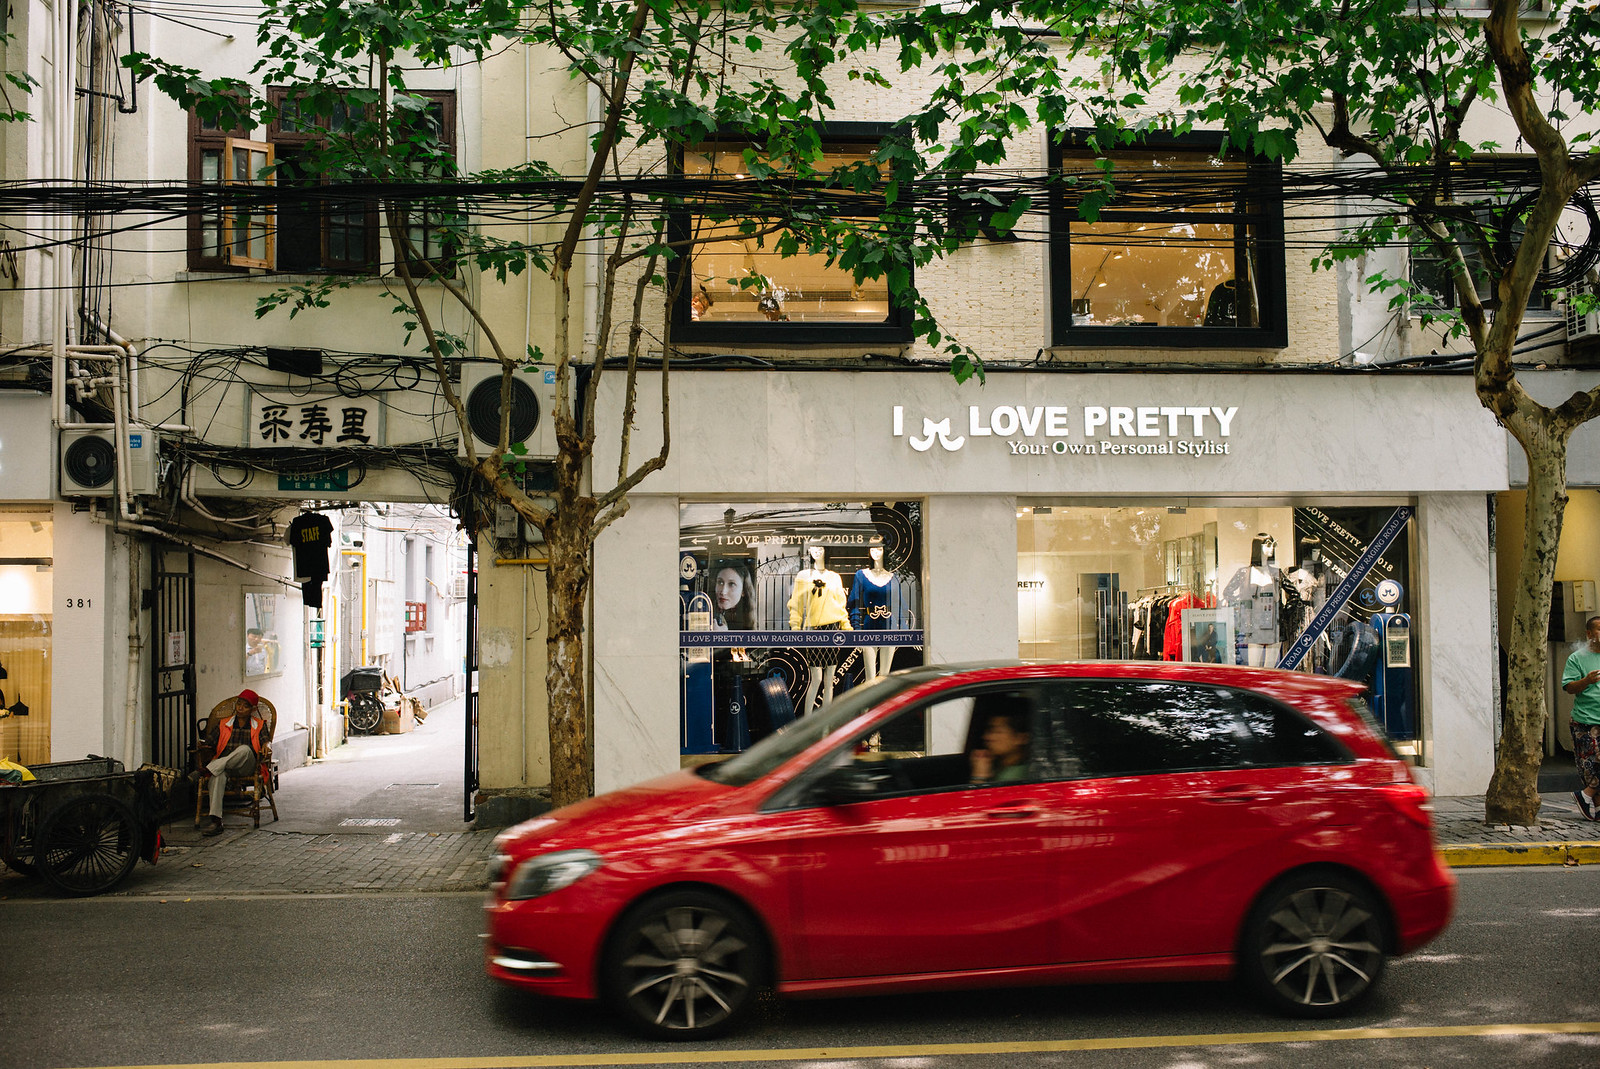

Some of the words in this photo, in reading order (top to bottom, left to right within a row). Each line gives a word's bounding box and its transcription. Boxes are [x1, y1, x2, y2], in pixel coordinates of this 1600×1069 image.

[259, 404, 371, 445] 采寿里
[892, 405, 904, 437] I
[969, 405, 1069, 437] LOVE
[1084, 406, 1239, 437] PRETTY
[1007, 440, 1049, 455] Your
[1052, 440, 1096, 455] Own
[1100, 440, 1174, 455] Personal
[1177, 440, 1230, 457] Stylist
[301, 526, 320, 543] STAFF
[717, 535, 723, 545] I
[726, 535, 760, 545] LOVE
[763, 535, 811, 545] PRETTY
[1329, 521, 1362, 547] PRETTY
[1316, 606, 1333, 627] LOVE
[1330, 582, 1351, 608] PRETTY
[1350, 563, 1365, 582] 18AW
[1364, 538, 1385, 565] RAGING
[1383, 519, 1400, 540] ROAD
[1017, 580, 1045, 588] RETTY
[66, 598, 92, 608] 381
[883, 634, 914, 642] PRETTY
[1285, 646, 1303, 668] ROAD
